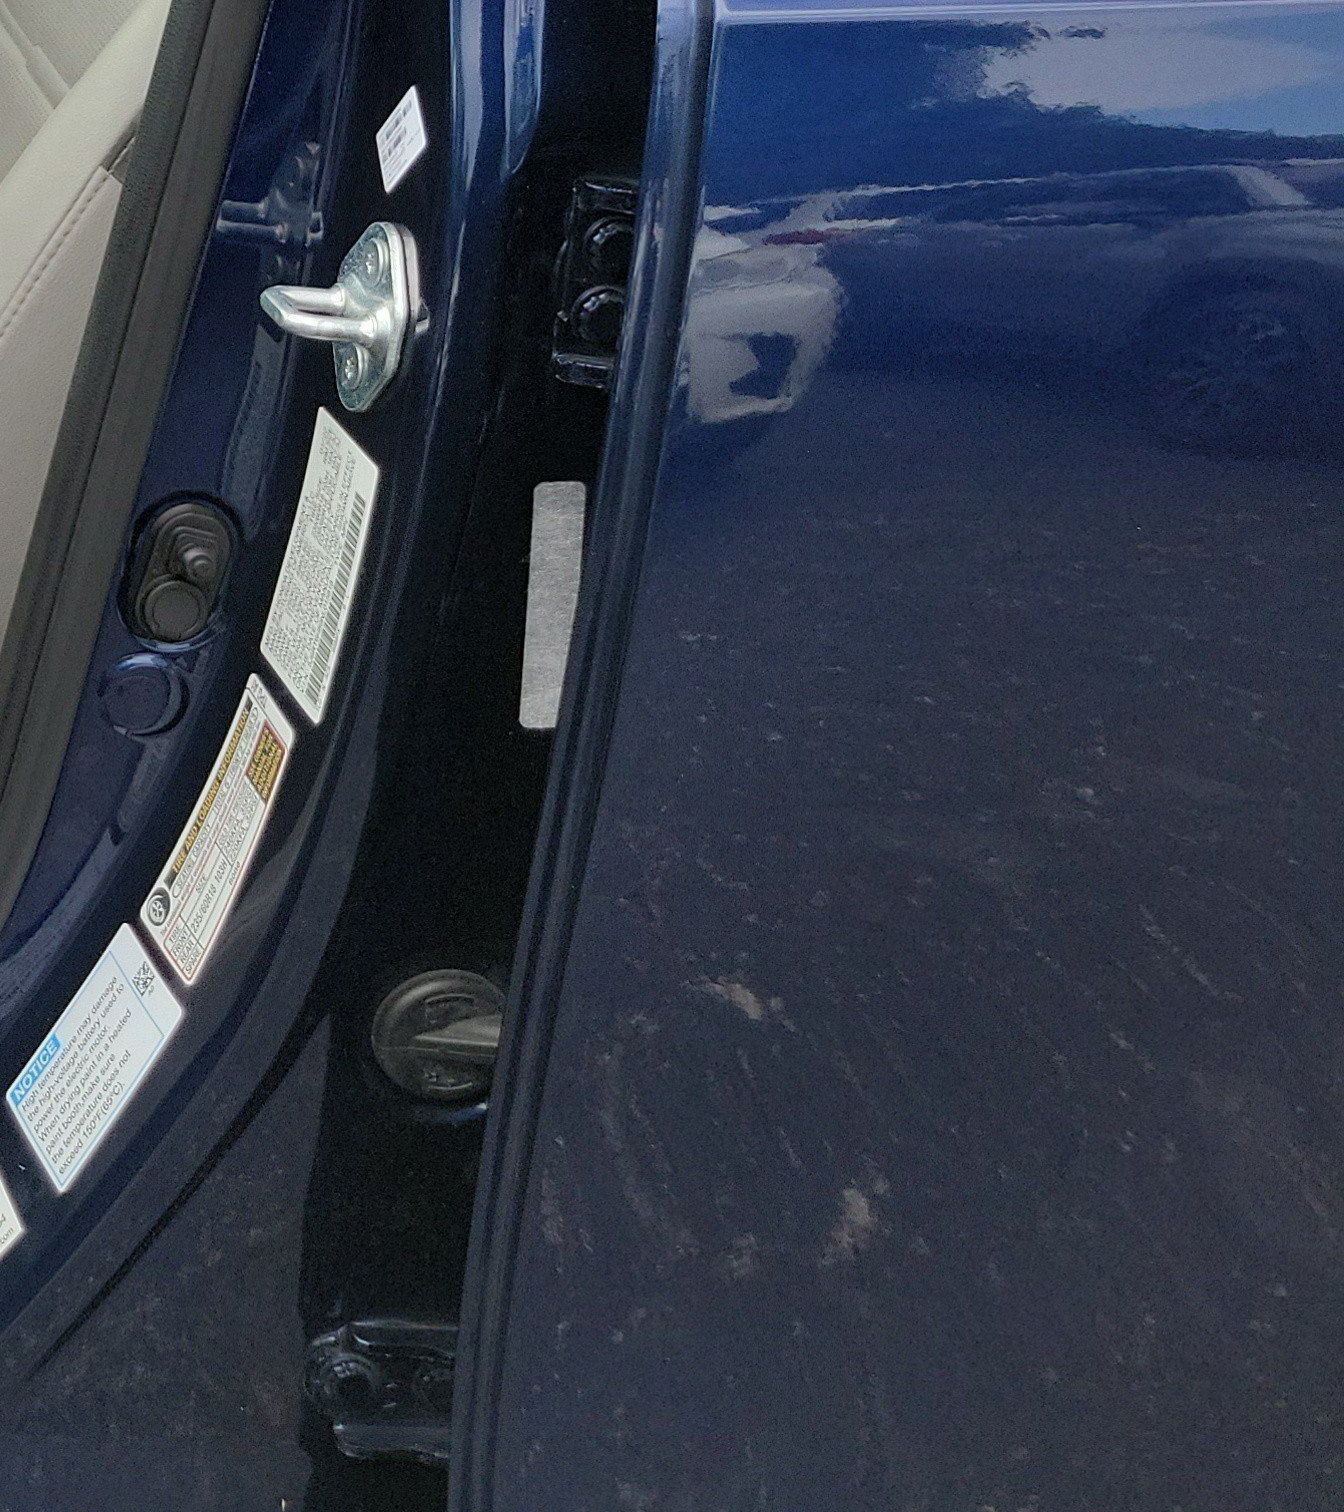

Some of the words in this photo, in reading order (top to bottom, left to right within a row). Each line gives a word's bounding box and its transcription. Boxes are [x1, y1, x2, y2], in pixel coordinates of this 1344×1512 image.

[183, 822, 198, 852] AND
[215, 705, 249, 782] INFORMATION
[172, 926, 188, 959] FRONT
[190, 879, 216, 936] 235/60R18
[13, 1036, 57, 1103] NOTICE
[21, 1086, 38, 1112] High
[37, 1033, 76, 1090] temperature
[75, 1013, 91, 1036] may
[89, 975, 117, 1015] damage
[26, 1104, 39, 1123] the
[38, 1049, 78, 1107] high-voltage
[77, 1018, 101, 1051] battery
[99, 991, 117, 1019] used
[115, 982, 124, 995] to
[33, 1101, 54, 1134] power
[53, 1086, 66, 1104] the
[65, 1052, 89, 1088] electric
[37, 1112, 60, 1144] When
[57, 1084, 81, 1116] drying
[79, 1058, 97, 1087] paint
[95, 1050, 104, 1062] in
[107, 1006, 132, 1044] heated
[46, 1125, 63, 1155] paint
[99, 1051, 116, 1076] sure
[51, 1146, 64, 1165] the
[62, 1090, 102, 1148] temperature
[100, 1066, 120, 1093] does
[118, 1047, 131, 1068] not
[58, 1136, 83, 1176] exceed
